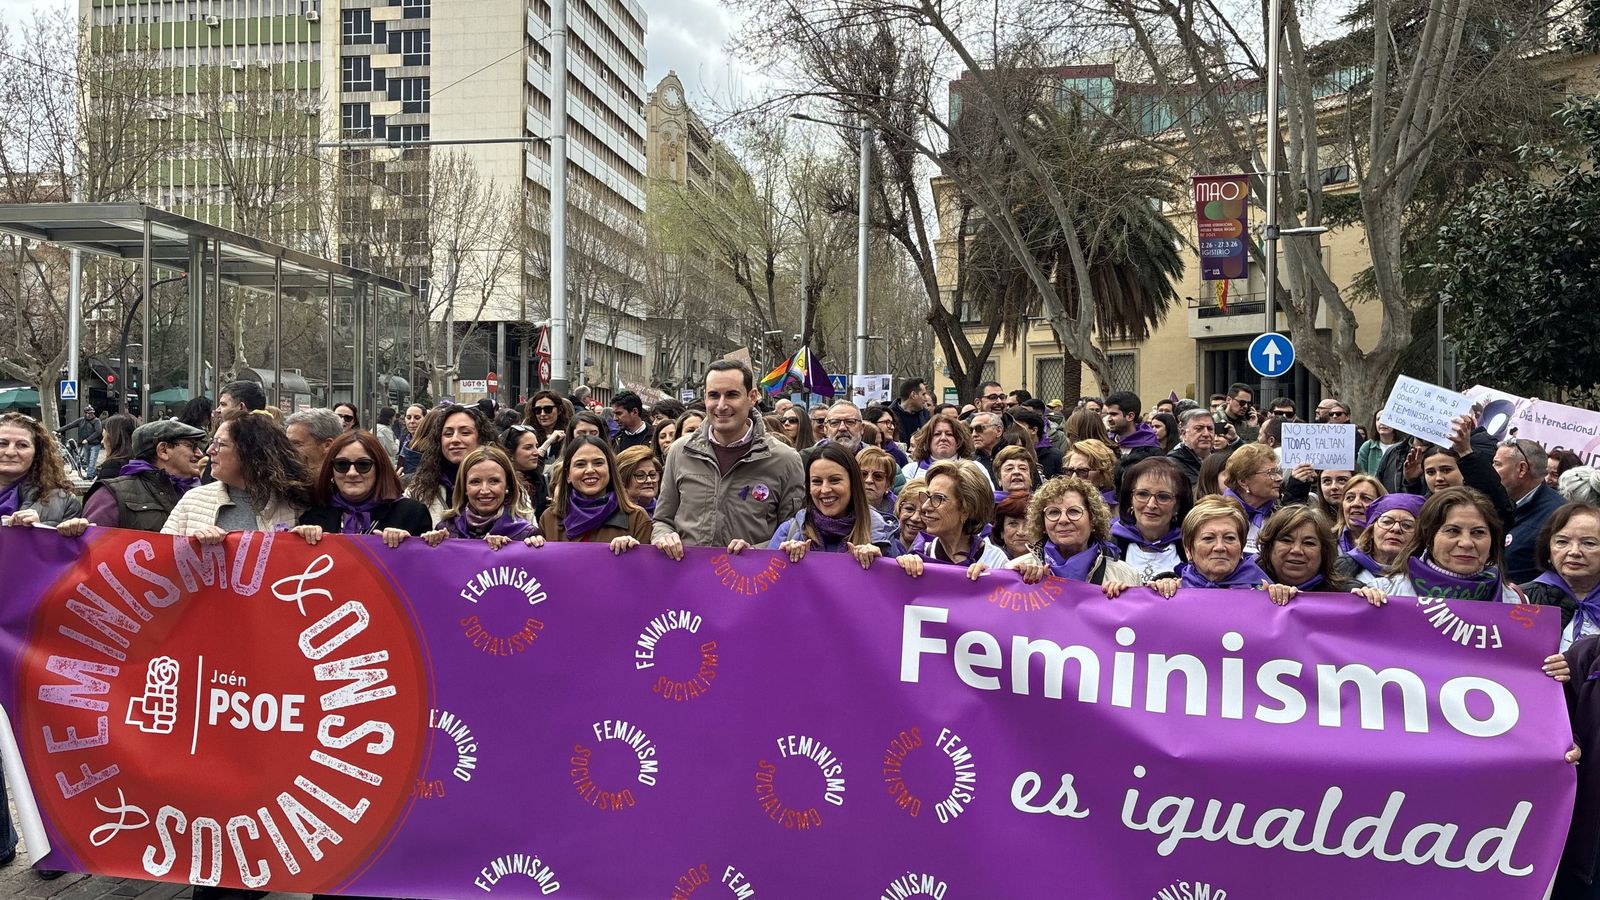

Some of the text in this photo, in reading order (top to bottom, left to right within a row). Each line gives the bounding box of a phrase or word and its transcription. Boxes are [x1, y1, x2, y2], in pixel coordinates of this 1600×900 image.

[1196, 182, 1240, 202] MAO
[1392, 402, 1448, 428] FEMINISTAS QUE
[1396, 393, 1413, 404] ODIAS
[1439, 408, 1453, 417] LAS
[1400, 382, 1419, 394] ALGO
[1436, 394, 1448, 405] MAL
[1519, 408, 1533, 422] Día
[1284, 424, 1347, 435] NO ESTAMOS
[1284, 437, 1345, 450] TODAS FALTAN
[1395, 417, 1406, 426] LOS
[1410, 422, 1447, 439] VIOLADORES
[1284, 452, 1301, 464] LAS
[460, 566, 547, 605] FEMINISMO
[710, 553, 787, 595] SOCIALISMO
[460, 614, 545, 657] SOCIALISMO
[635, 609, 702, 670] FEMINISMO
[38, 530, 275, 800] FEMINISMO
[210, 669, 247, 687] Jaén
[653, 641, 719, 702] SOCIALISMO
[900, 604, 1521, 738] Feminismo
[208, 689, 305, 732] PSOE
[142, 600, 397, 888] SOCIALISMO
[592, 719, 658, 787] FEMINISMO
[570, 743, 637, 811] SOCIALISMO
[776, 735, 846, 806] FEMINISMO
[883, 726, 922, 817] SOCIALISMO
[935, 728, 976, 824] FEMINISMO
[755, 760, 822, 830] SOCIALISMO
[1010, 765, 1534, 877] es igualdad
[474, 853, 561, 895] FEMINISMO
